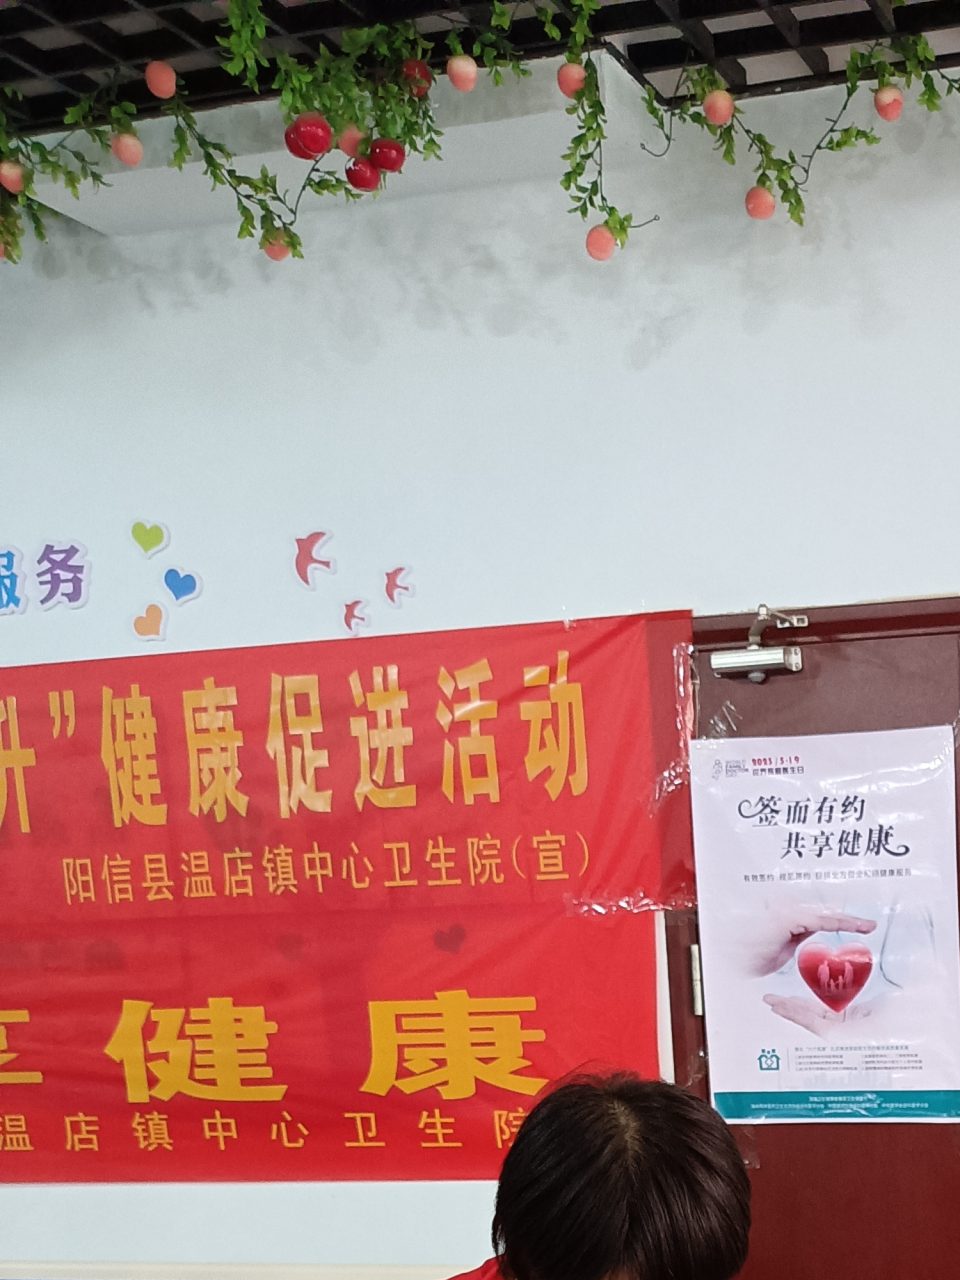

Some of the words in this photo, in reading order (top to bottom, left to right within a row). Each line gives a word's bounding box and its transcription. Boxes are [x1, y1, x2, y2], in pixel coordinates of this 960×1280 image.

[738, 795, 865, 828] 签而有约
[780, 824, 911, 860] 共享健康
